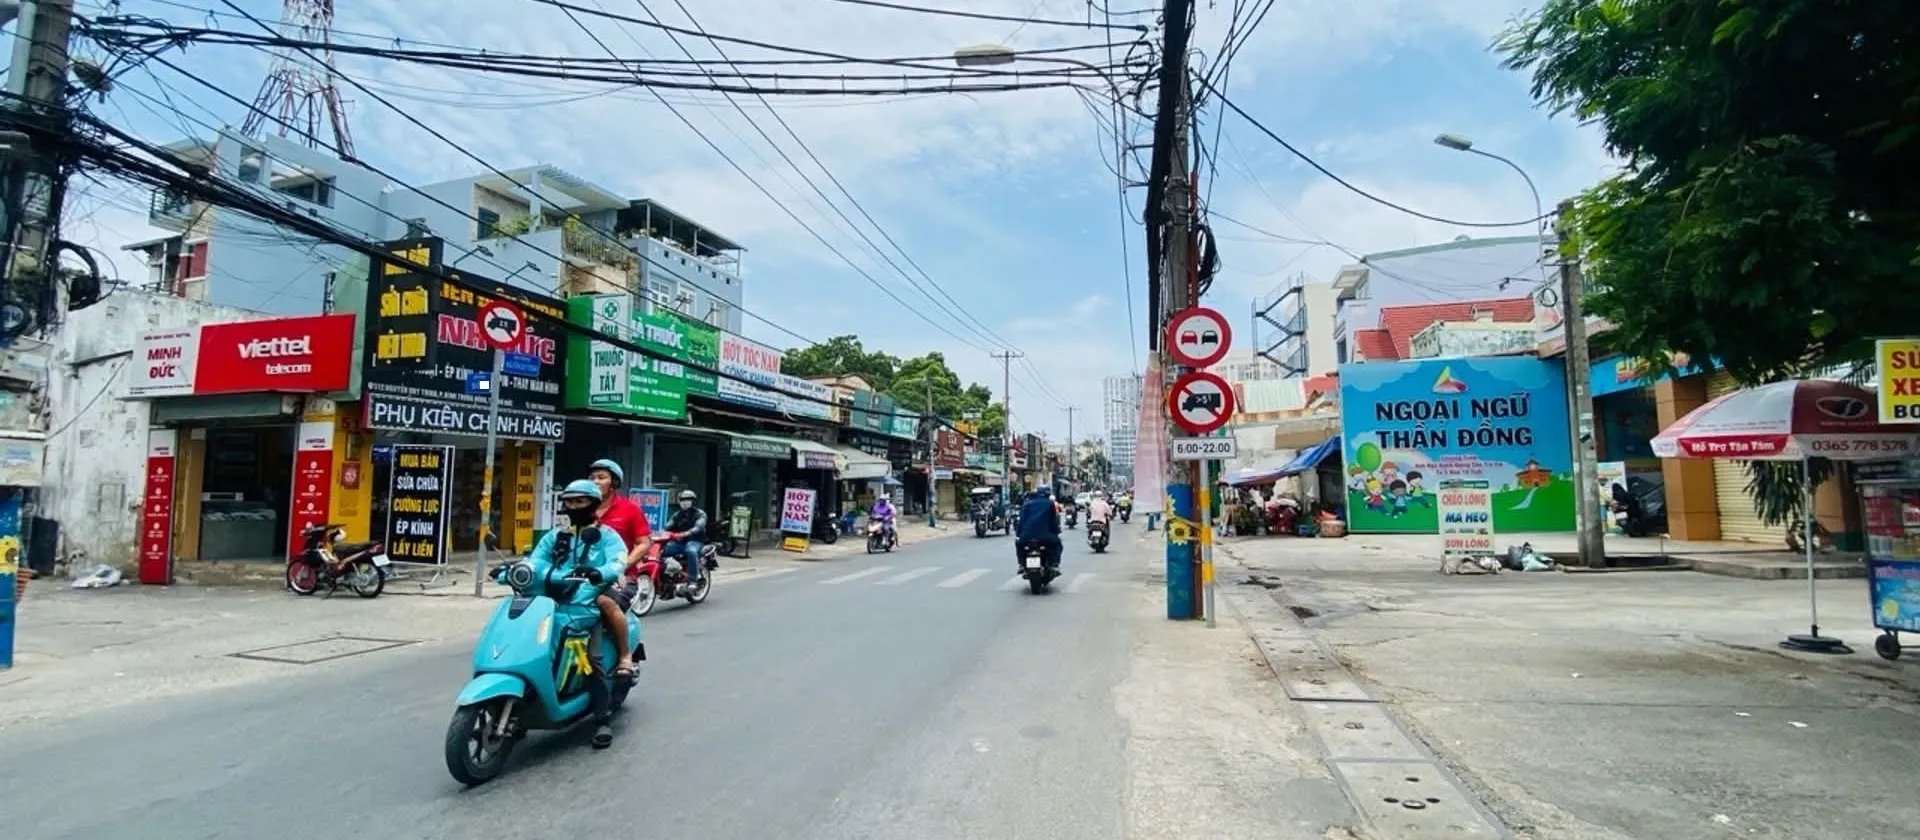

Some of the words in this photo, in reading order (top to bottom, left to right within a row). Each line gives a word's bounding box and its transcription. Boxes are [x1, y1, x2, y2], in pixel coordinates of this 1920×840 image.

[646, 323, 683, 349] THUỐC
[147, 347, 182, 361] MINH
[238, 335, 312, 358] viettel
[594, 346, 624, 367] THUỐC
[723, 339, 740, 363] HỚT
[743, 345, 759, 368] TÓC
[761, 351, 778, 373] NAM
[150, 362, 175, 378] ĐỨC
[265, 364, 311, 375] telecom
[1375, 399, 1459, 424] NGOẠI
[1471, 392, 1530, 418] NGỮ
[374, 403, 415, 428] PHỤ
[421, 405, 463, 430] KIỆN
[468, 413, 519, 433] CHNH
[523, 415, 561, 437] HÃNG
[1376, 420, 1447, 449] THẦN
[1458, 419, 1532, 447] ĐỒNG
[1812, 440, 1849, 451] 0365
[1852, 440, 1879, 451] 778
[400, 454, 418, 468] MUA
[421, 452, 439, 468] BÁN
[397, 472, 414, 490] SỬA
[416, 474, 439, 491] CHỮA
[787, 491, 811, 502] HỚT
[393, 496, 421, 512] CƯỜNG
[423, 498, 439, 516] LỰC
[787, 502, 809, 512] TÓC
[784, 512, 810, 521] NAM
[1465, 511, 1488, 523] HEO
[396, 517, 409, 534] ÉP
[410, 518, 434, 535] KÍNH
[393, 538, 411, 555] LẤY
